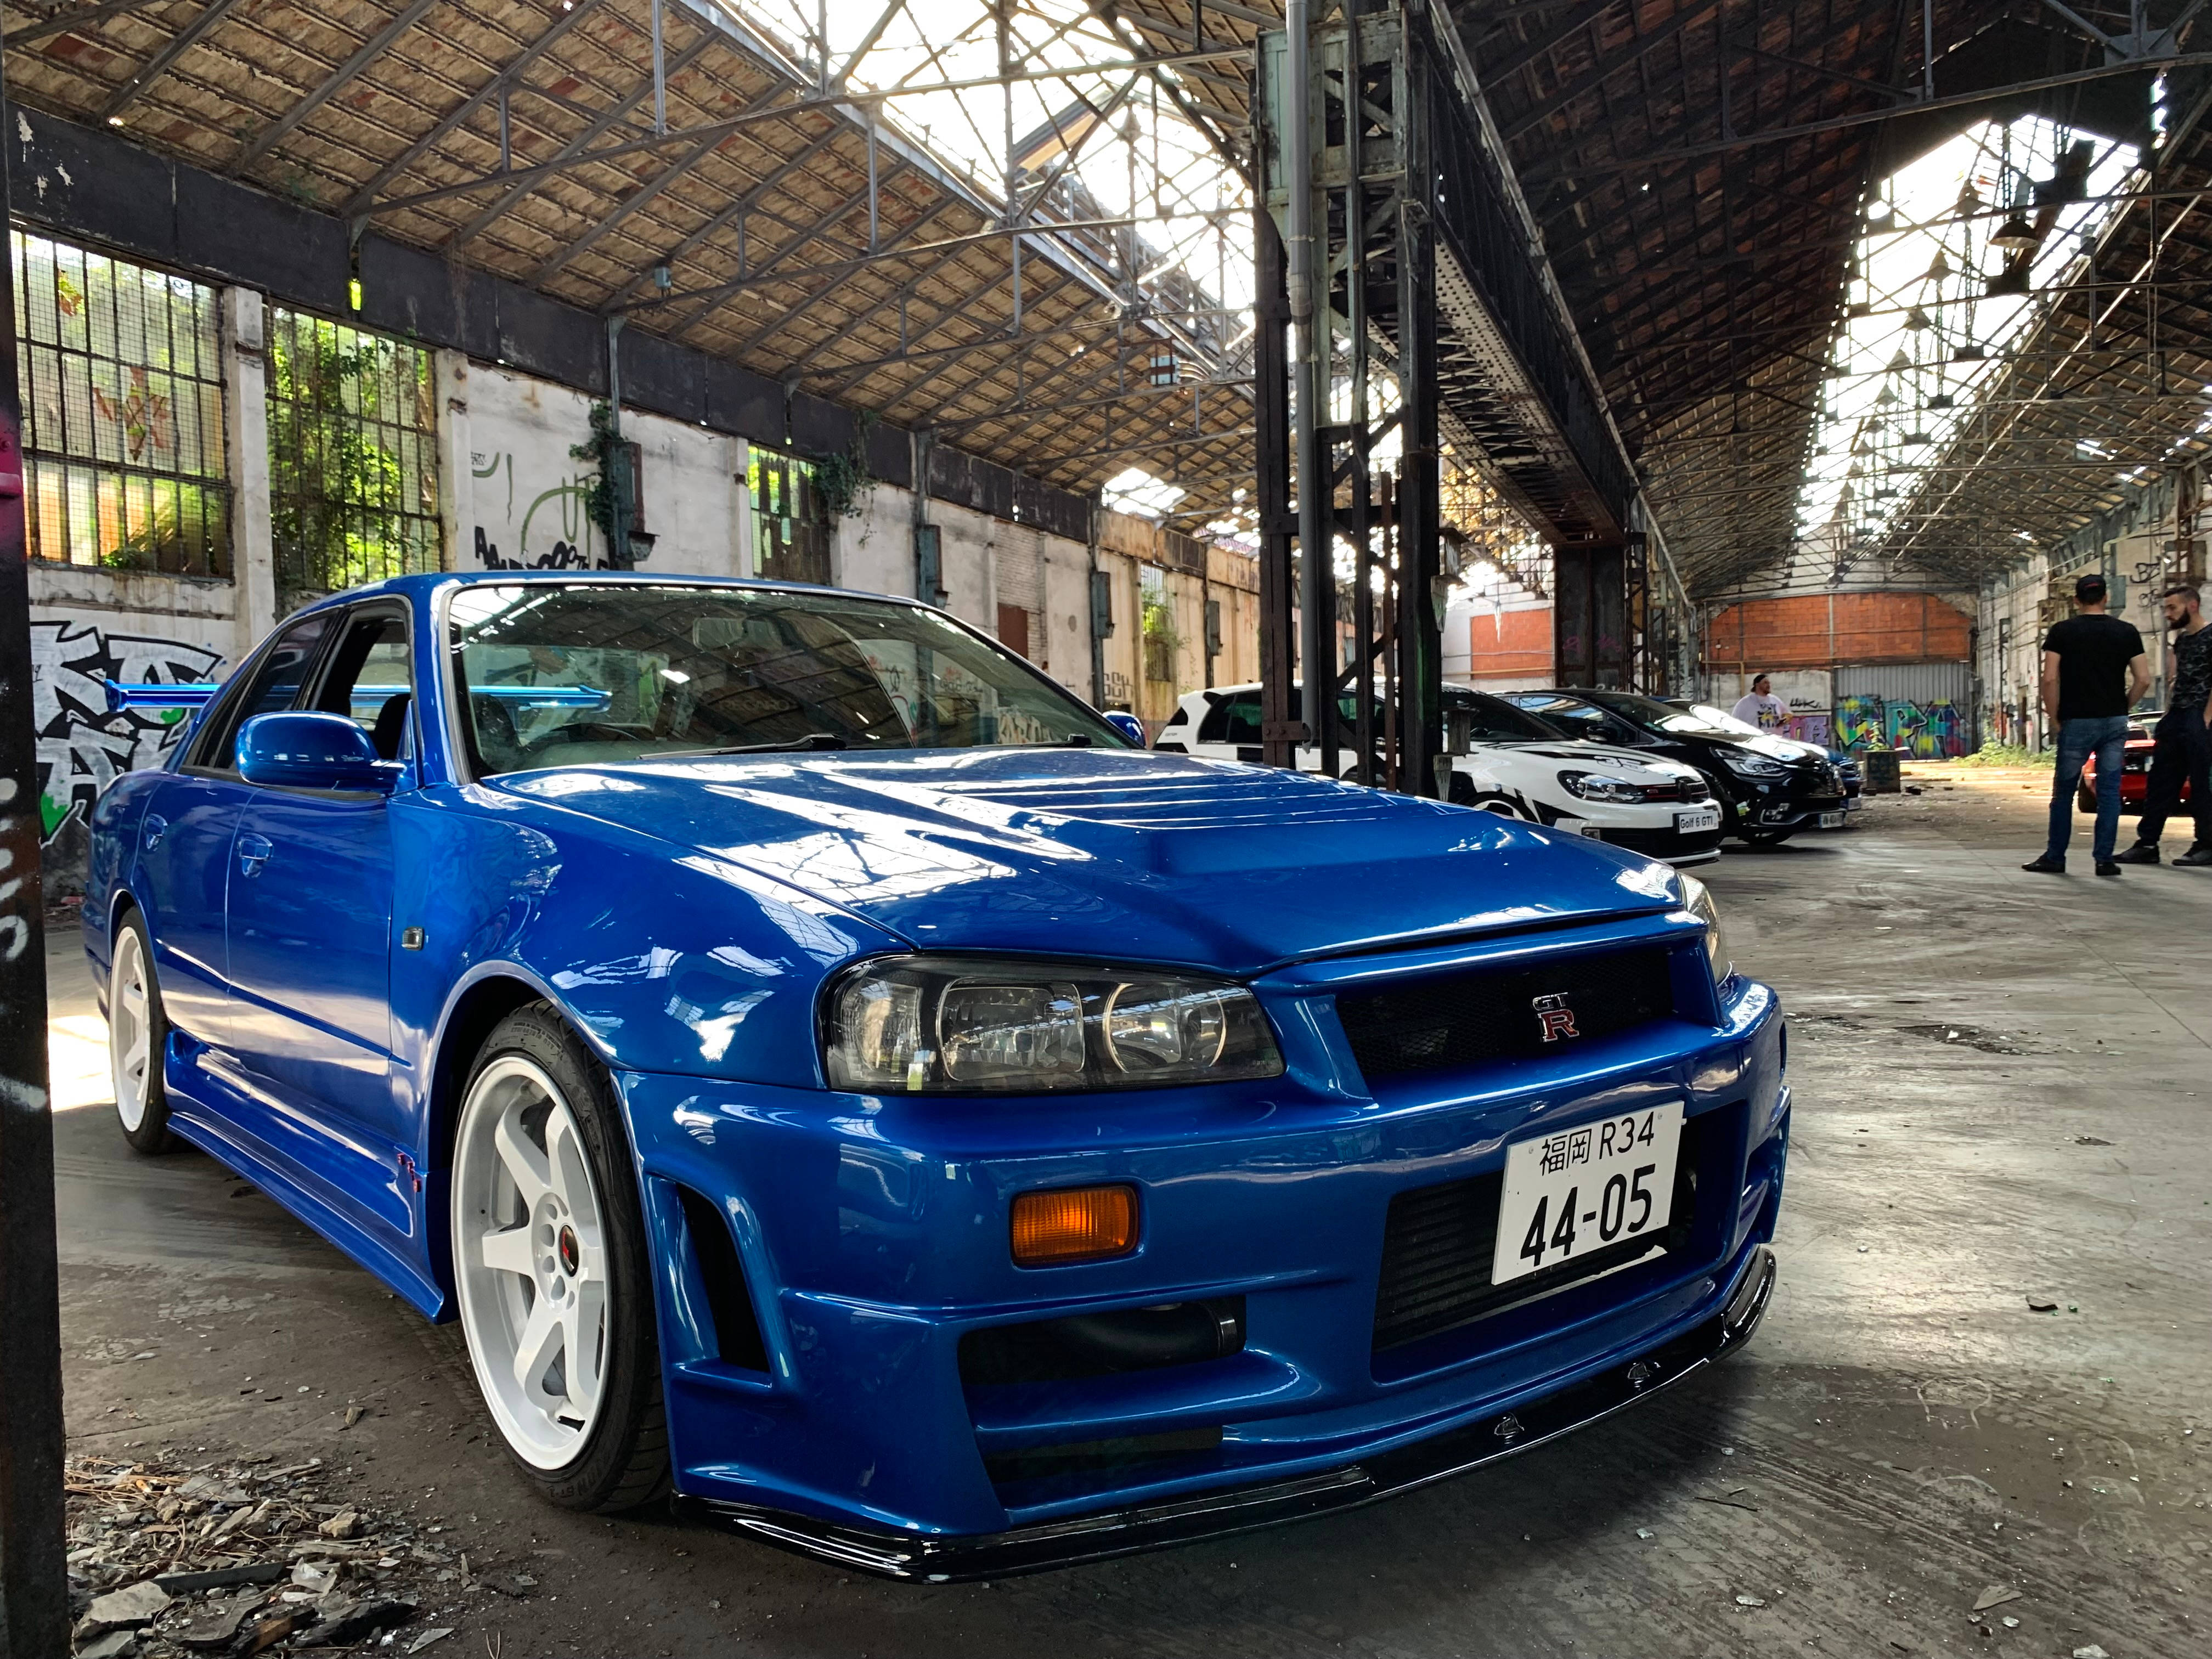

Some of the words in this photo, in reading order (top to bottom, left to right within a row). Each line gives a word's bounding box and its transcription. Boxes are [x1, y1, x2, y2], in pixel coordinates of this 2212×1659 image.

[1594, 755, 1646, 774] 35
[1680, 817, 1694, 829] Golf
[1696, 817, 1700, 827] 6
[1702, 816, 1713, 826] GTI
[1539, 1128, 1592, 1176] 福岡
[1599, 1111, 1654, 1159] R34
[1520, 1164, 1656, 1267] 44-05
